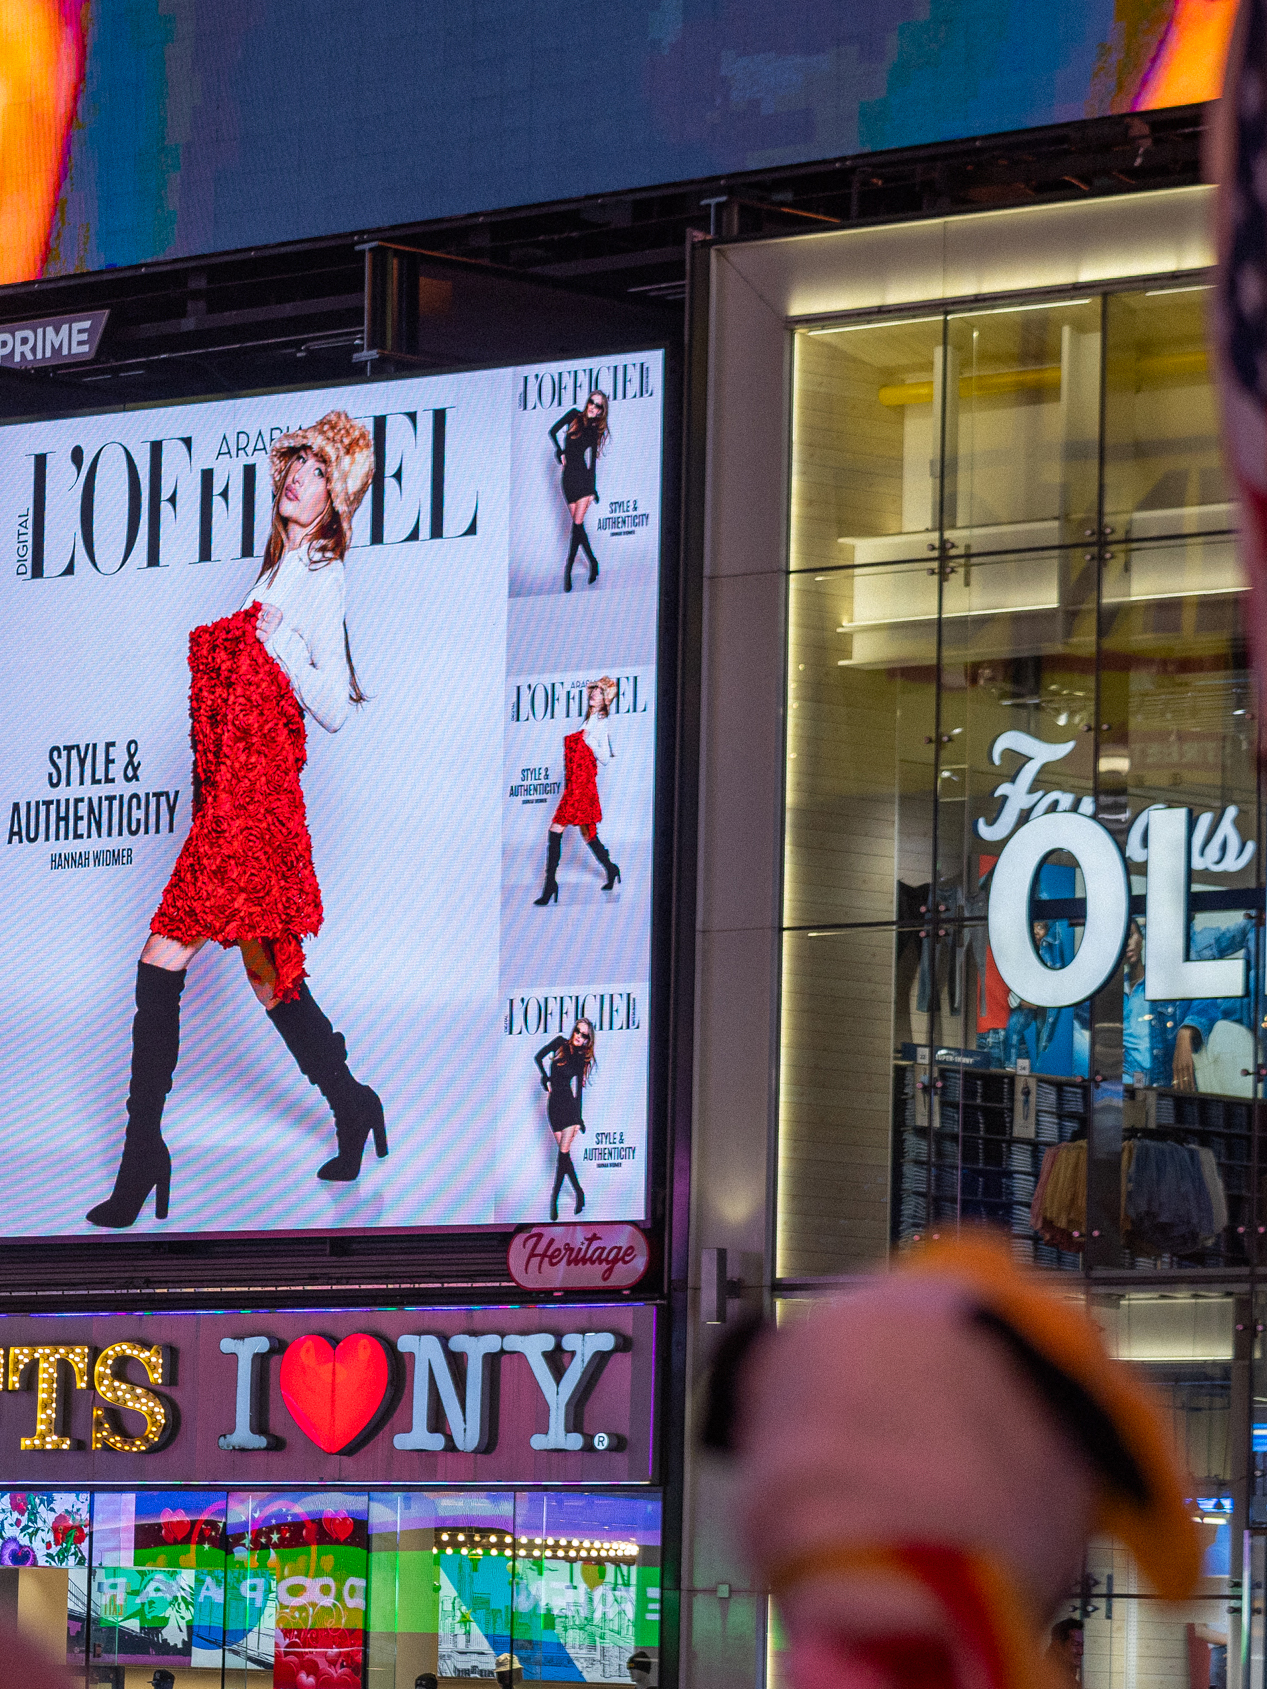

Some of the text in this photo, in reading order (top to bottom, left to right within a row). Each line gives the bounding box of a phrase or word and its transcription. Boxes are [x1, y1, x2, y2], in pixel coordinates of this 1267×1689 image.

[22, 406, 479, 581] L'OFFIEL
[608, 499, 638, 514] STYLE &
[597, 513, 649, 532] AUTHENTICITY
[16, 507, 30, 577] DIGITAL
[48, 739, 141, 789] STYLE &
[521, 766, 550, 782] STYLE &
[509, 782, 561, 797] AUTHENTICITY
[7, 790, 180, 844] AUTHENTICITY
[51, 848, 133, 870] HANNAH WIDMER
[988, 807, 1267, 1008] OL
[583, 1146, 636, 1161] AUTHENTICITY
[595, 1131, 624, 1146] STYLE &
[522, 1232, 637, 1282] Heritage
[218, 1336, 272, 1450] I
